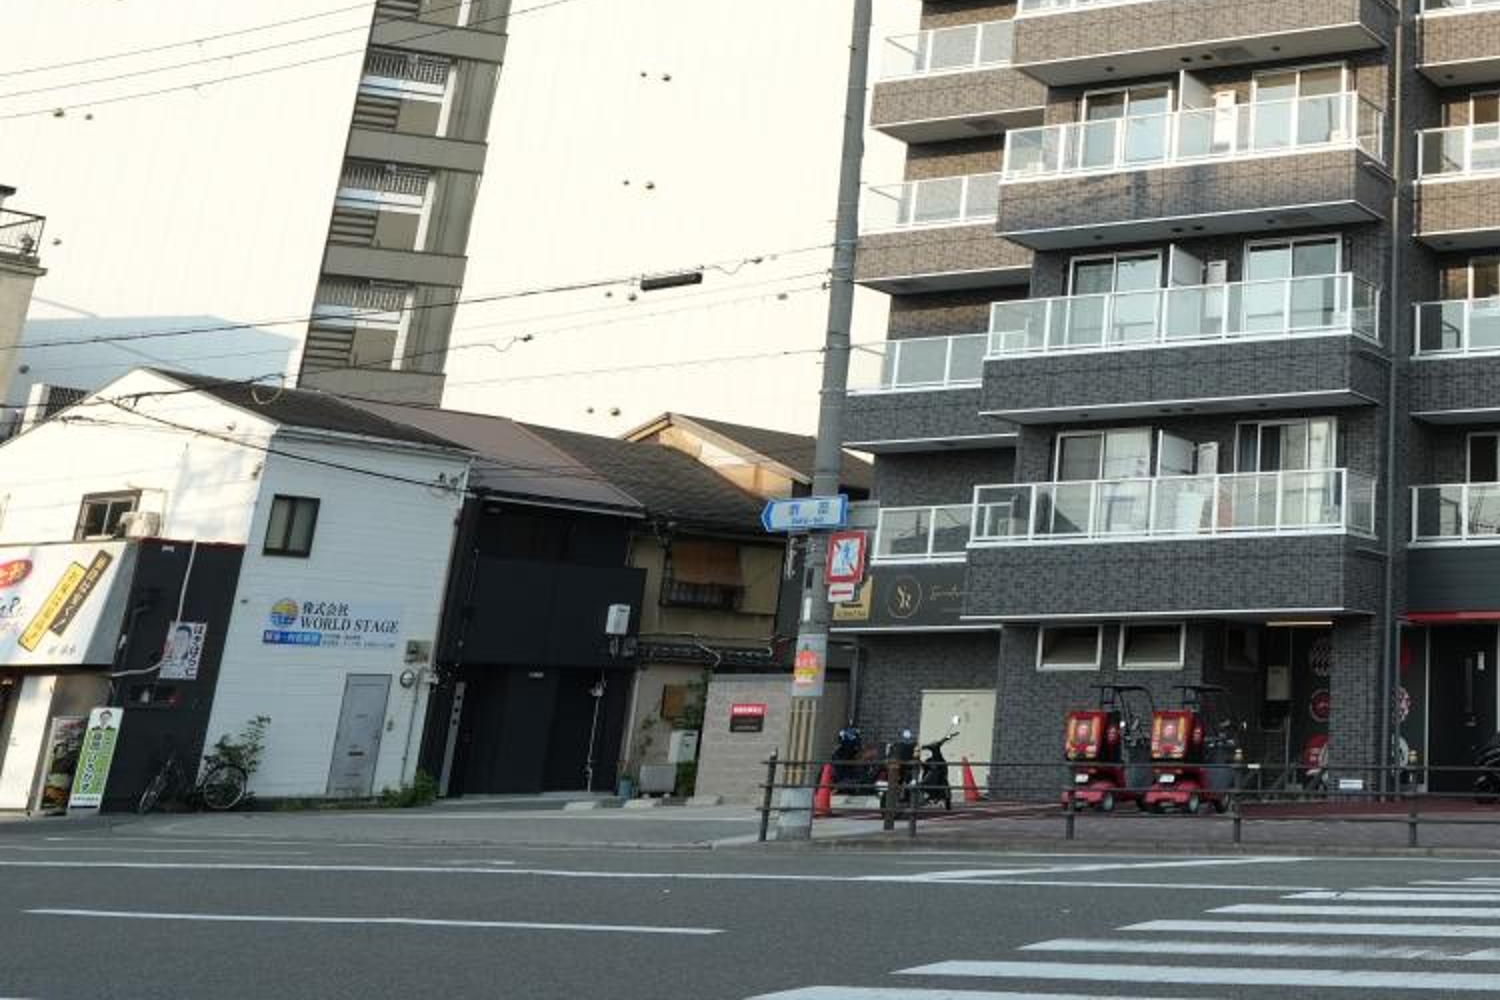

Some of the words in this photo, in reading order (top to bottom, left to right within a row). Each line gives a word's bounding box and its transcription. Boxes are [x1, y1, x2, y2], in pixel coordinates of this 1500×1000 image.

[302, 601, 350, 617] 株式会社
[300, 615, 351, 632] WORLD
[353, 618, 399, 634] STAGE
